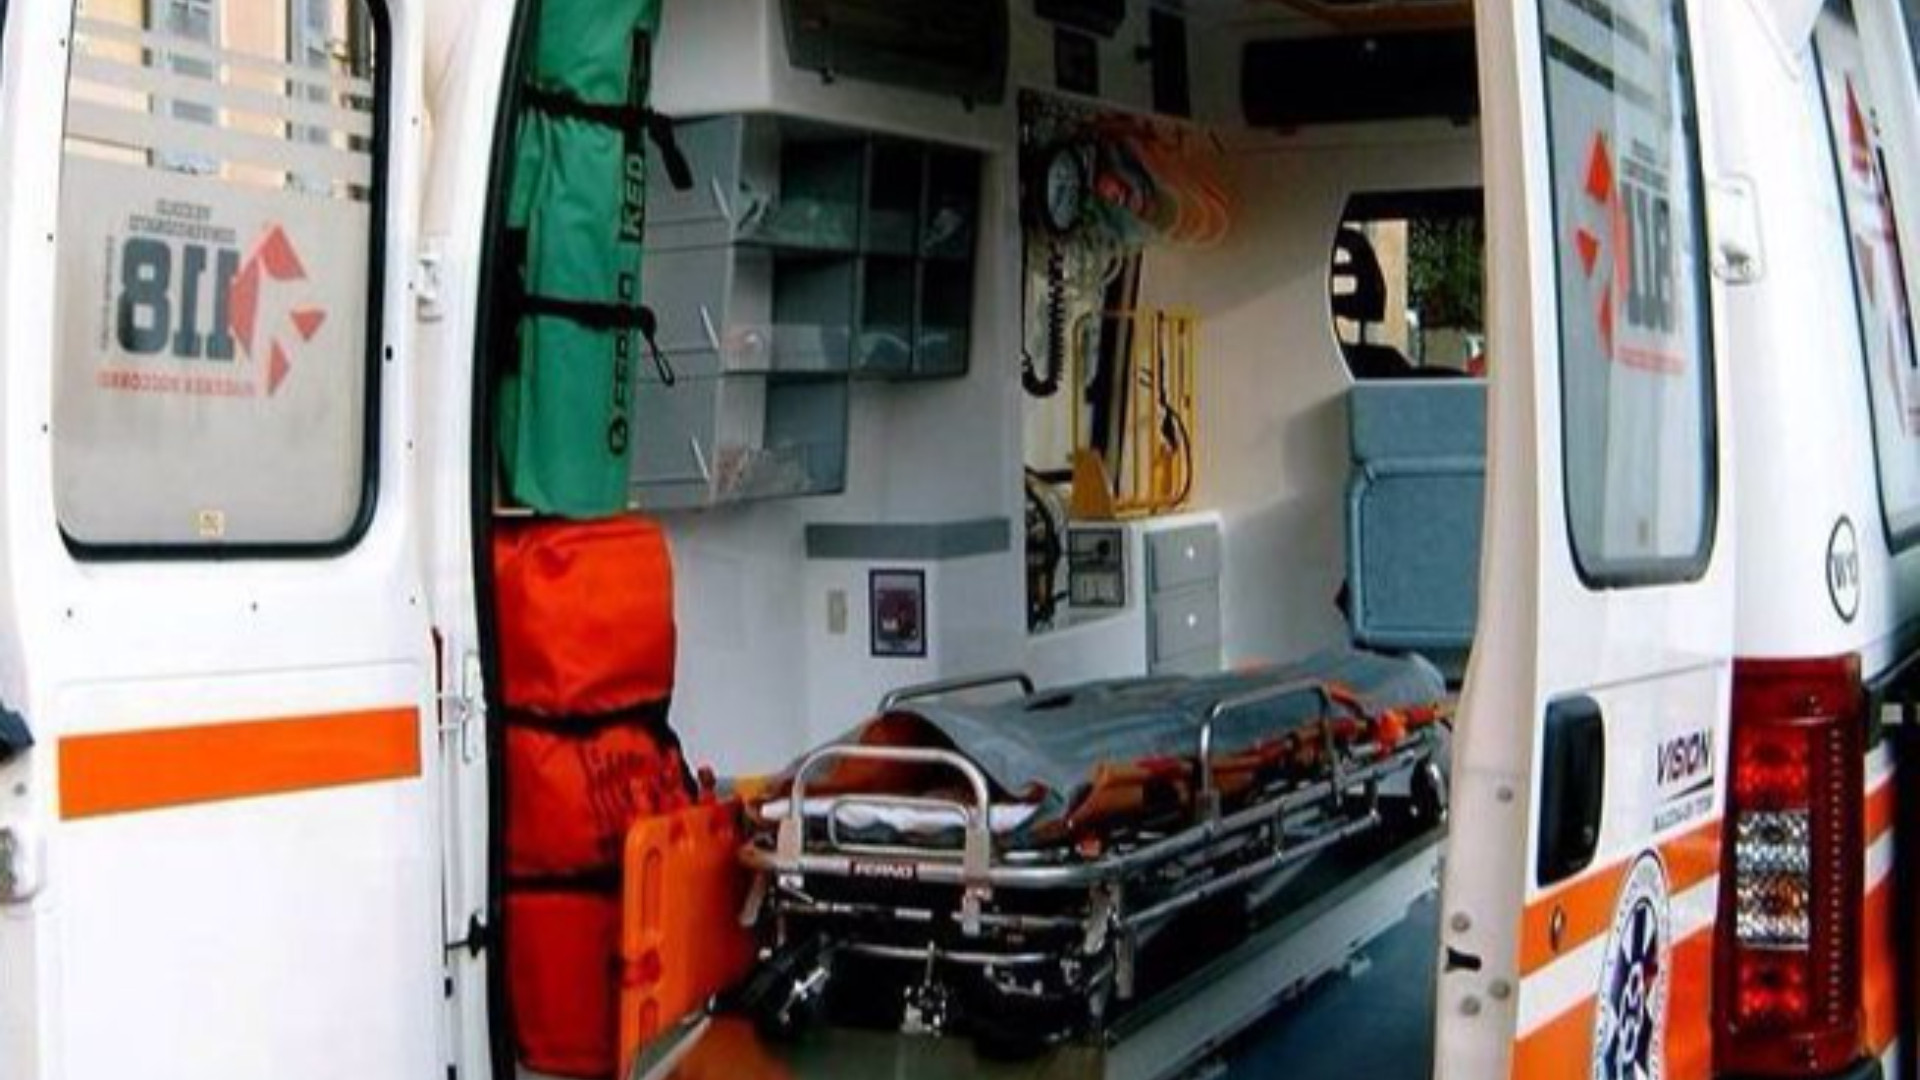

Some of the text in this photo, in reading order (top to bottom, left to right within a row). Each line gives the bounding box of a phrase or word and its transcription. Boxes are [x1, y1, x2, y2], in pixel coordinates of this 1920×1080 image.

[622, 153, 644, 236] KED
[614, 272, 633, 407] FERO
[1657, 729, 1713, 786] VISION
[854, 863, 915, 878] FERNO
